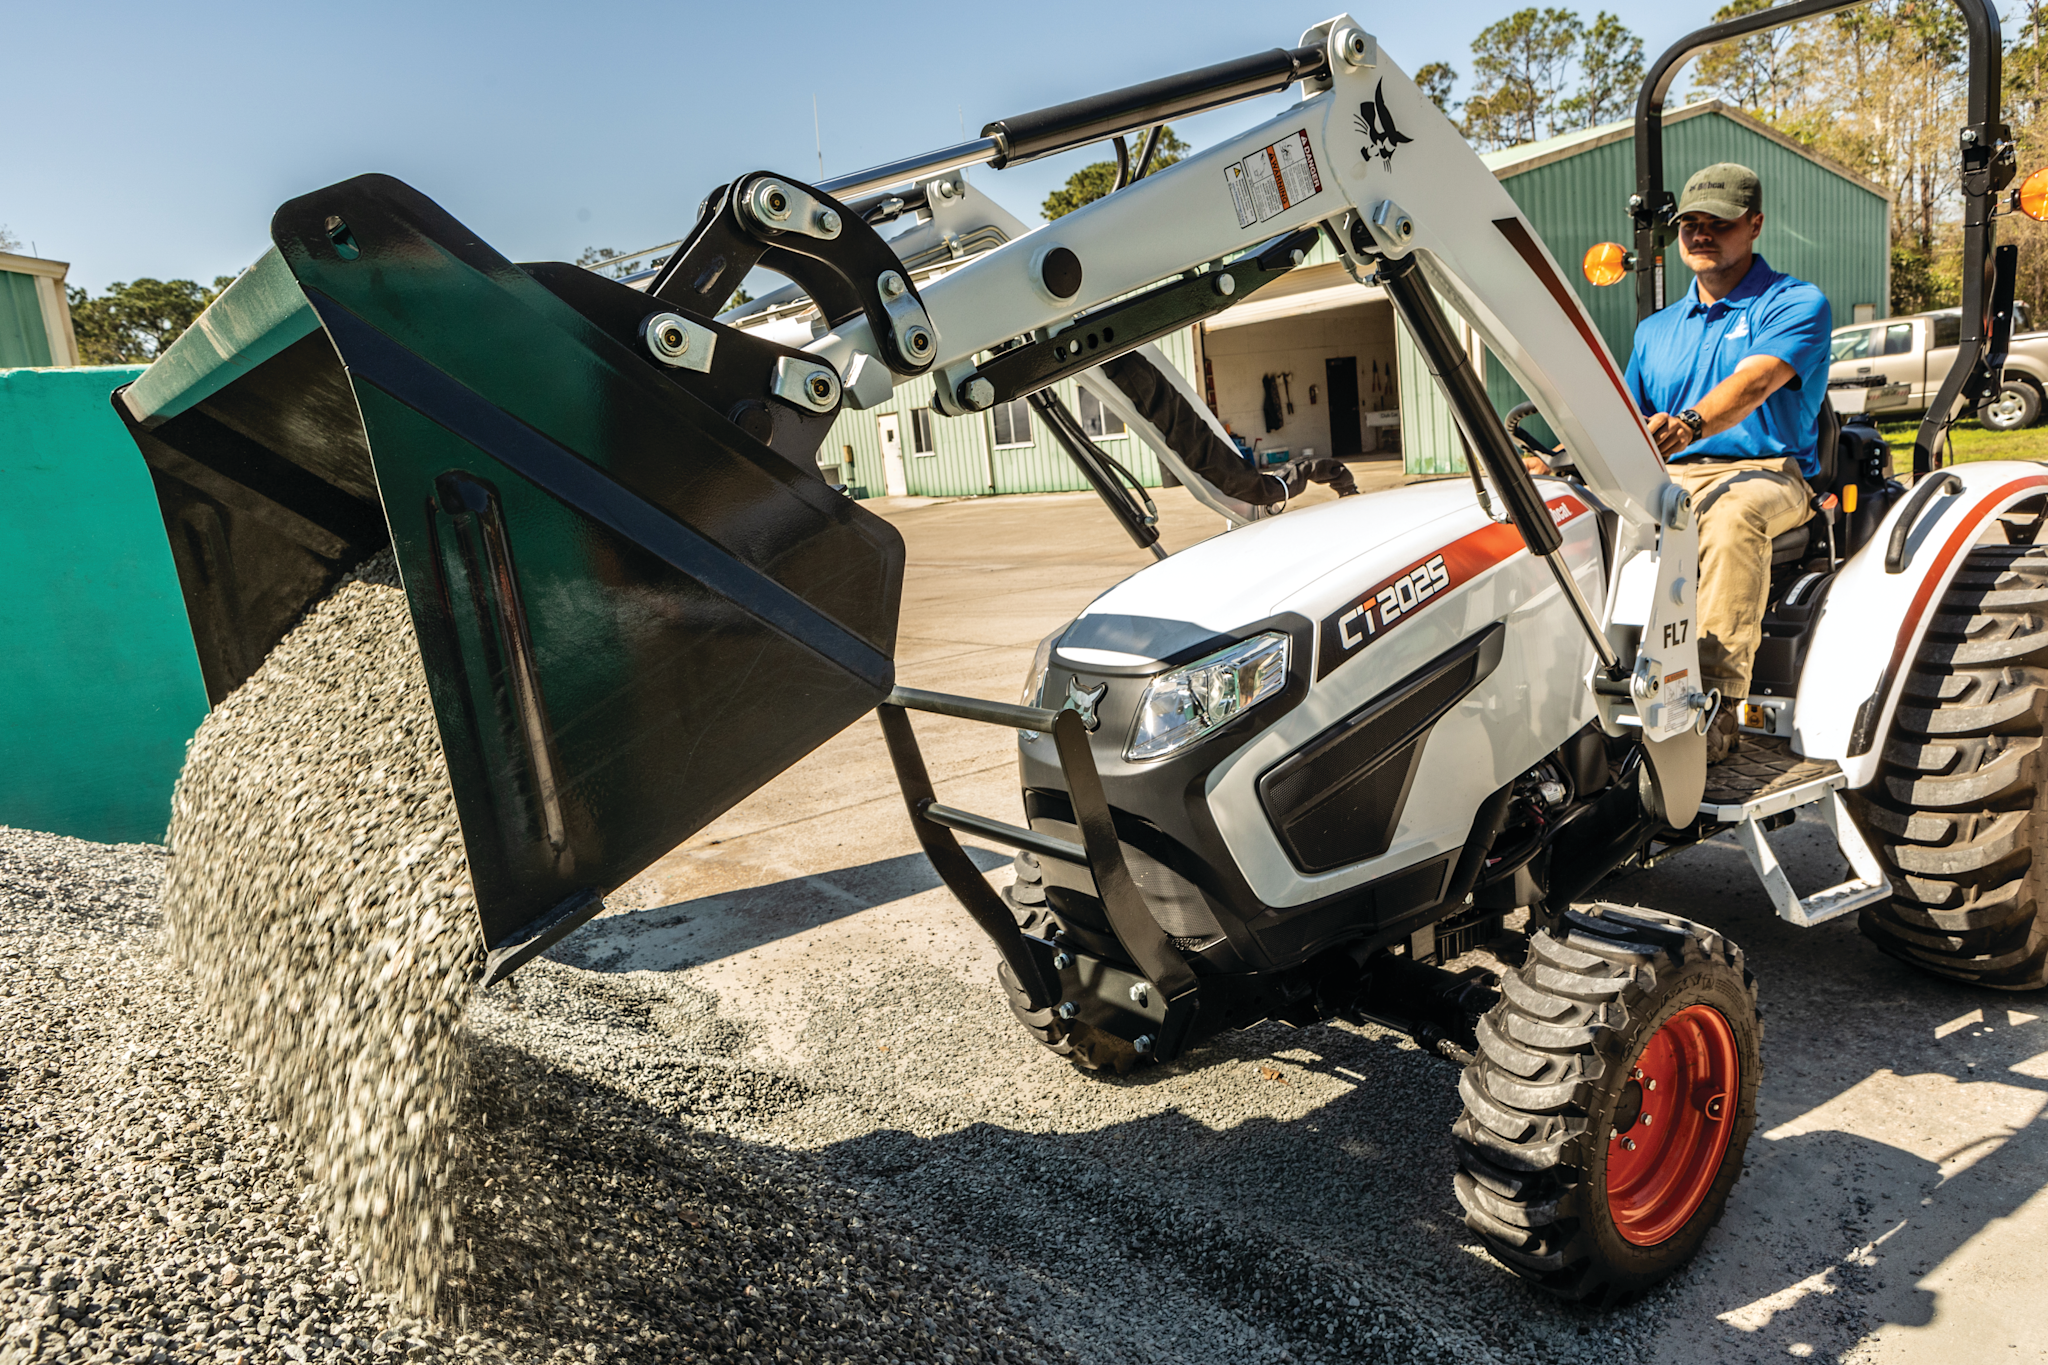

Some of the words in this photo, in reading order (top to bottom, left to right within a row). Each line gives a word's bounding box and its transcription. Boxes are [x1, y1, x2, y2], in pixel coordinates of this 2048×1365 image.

[1271, 161, 1288, 204] WARNING
[1304, 147, 1320, 187] DANGER
[1549, 502, 1572, 524] bcat
[1338, 554, 1450, 650] CT2025
[1664, 619, 1688, 649] FL7
